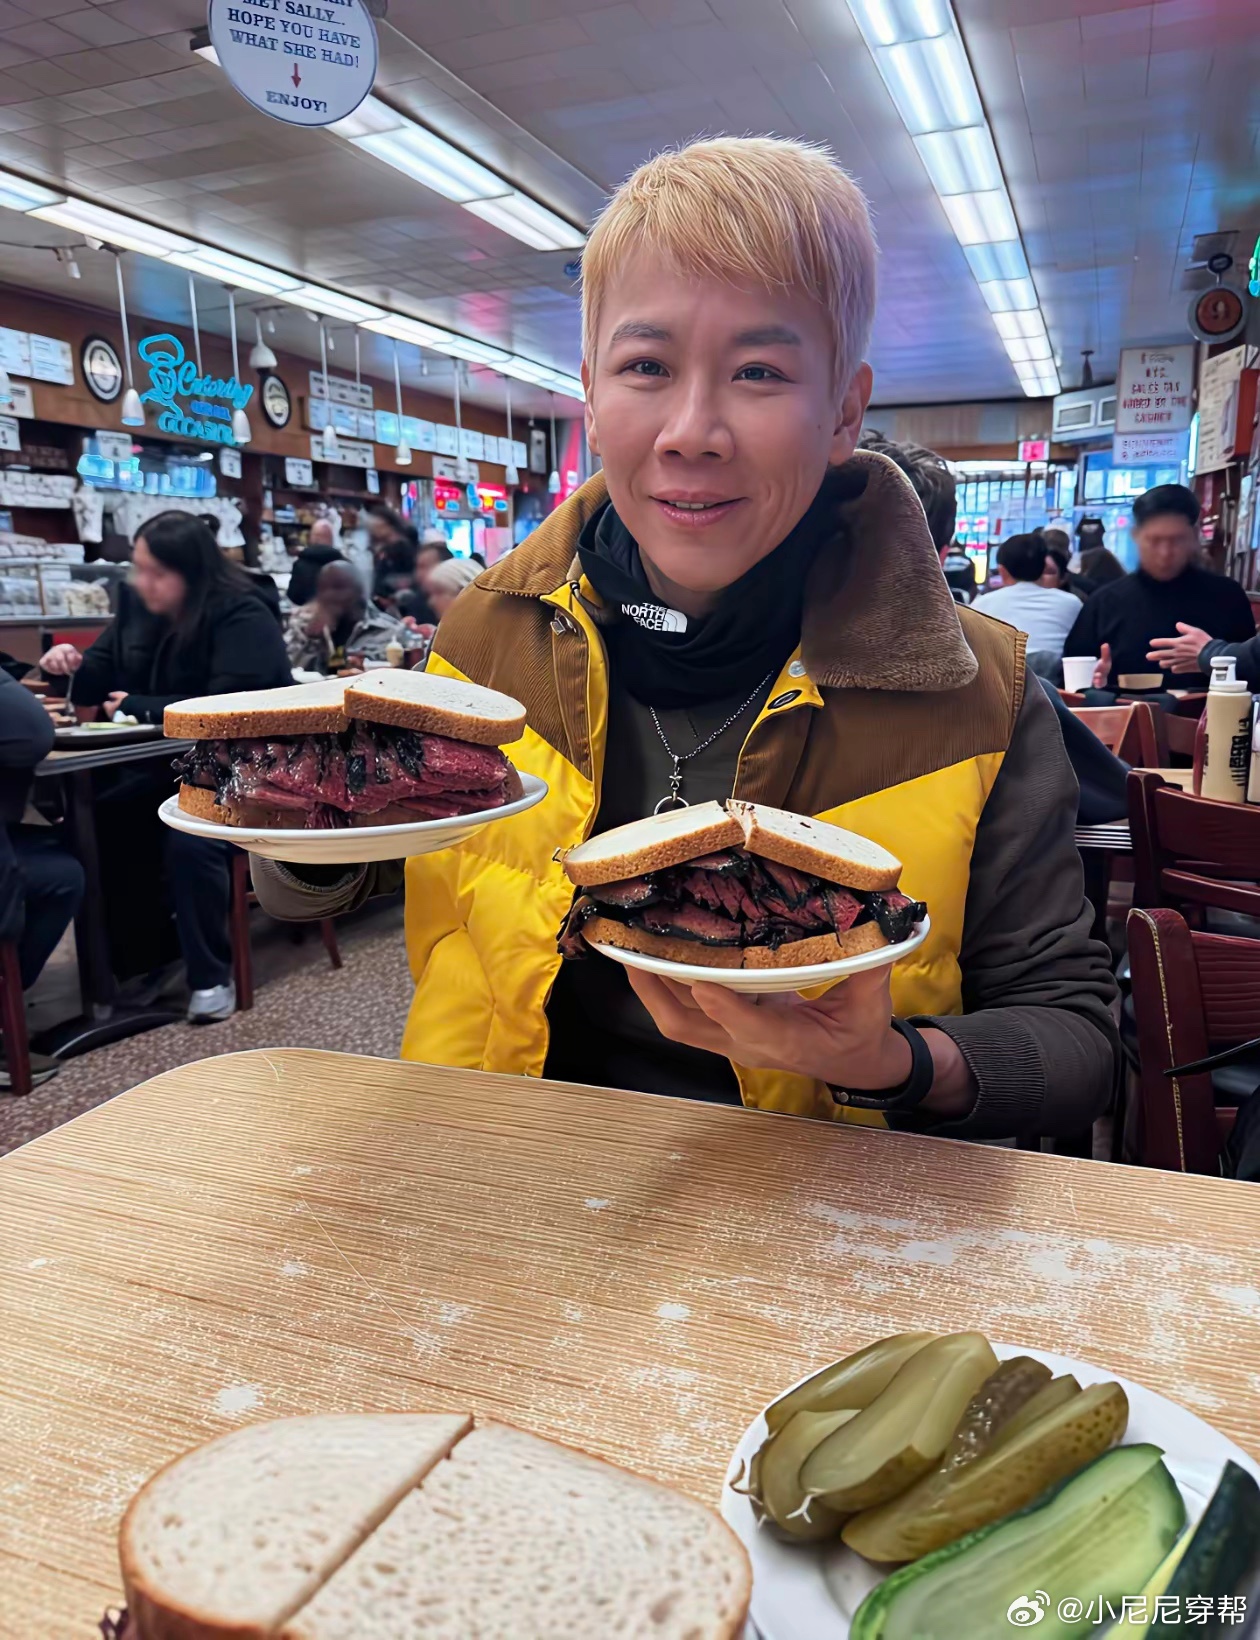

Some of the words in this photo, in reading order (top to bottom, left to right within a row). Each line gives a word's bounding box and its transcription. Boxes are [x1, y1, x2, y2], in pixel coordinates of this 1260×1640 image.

[227, 7, 276, 31] HOPE
[280, 20, 314, 38] YOU
[318, 28, 361, 49] HAVE
[229, 28, 278, 51] WHAT
[283, 41, 317, 60] SHE
[321, 48, 360, 68] HAD!
[265, 90, 328, 113] ENJOY!
[621, 603, 666, 620] NORTH
[642, 602, 667, 610] THE
[633, 616, 663, 631] FACE
